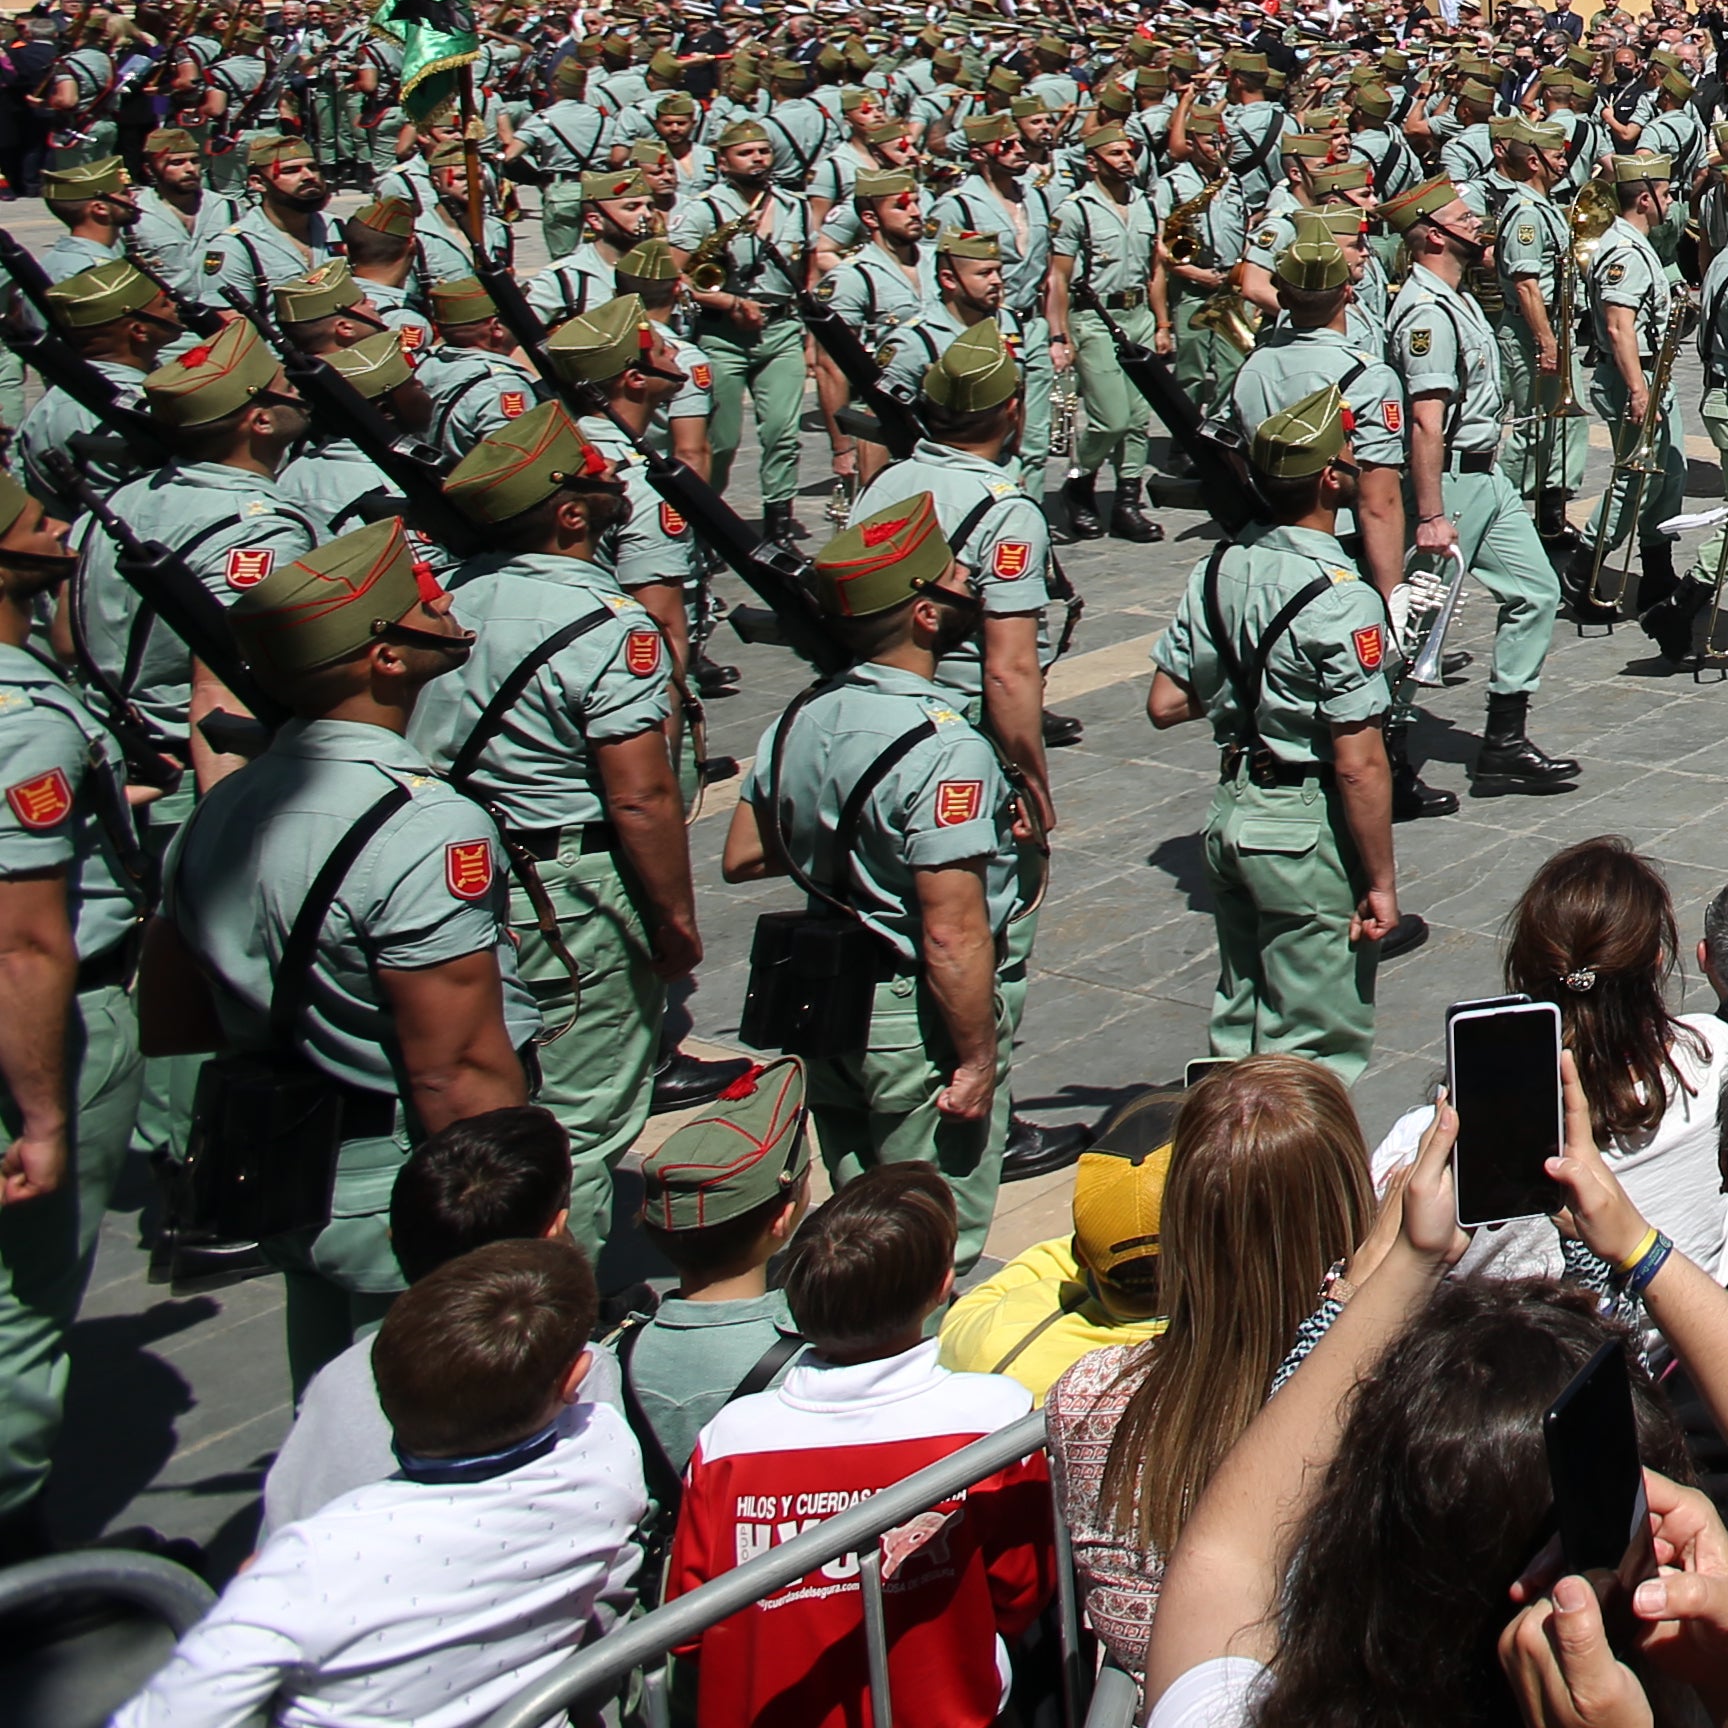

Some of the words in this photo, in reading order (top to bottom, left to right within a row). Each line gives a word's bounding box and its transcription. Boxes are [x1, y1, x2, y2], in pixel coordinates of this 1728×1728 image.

[736, 1495, 777, 1520] HILOS
[781, 1494, 793, 1518] Y
[796, 1488, 872, 1516] CUERDAS
